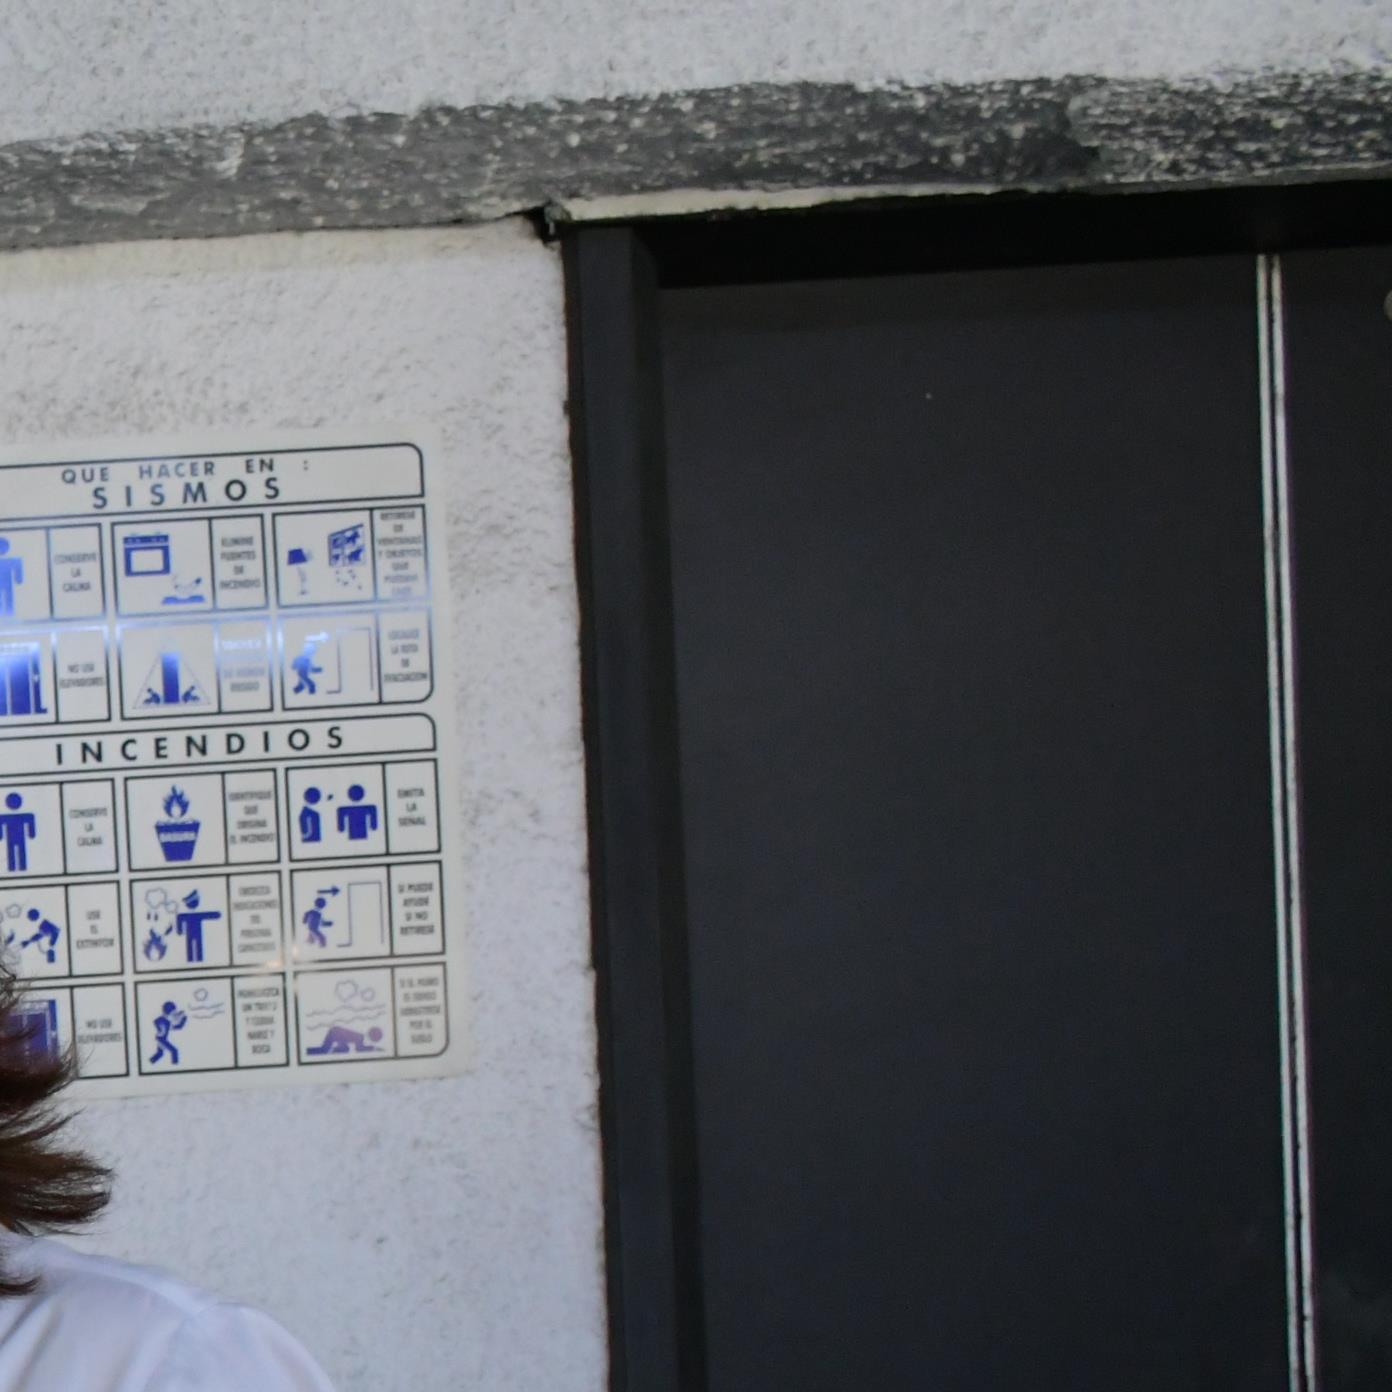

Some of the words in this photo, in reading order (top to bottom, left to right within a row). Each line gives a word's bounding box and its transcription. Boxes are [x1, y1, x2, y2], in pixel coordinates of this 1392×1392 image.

[61, 467, 110, 485] QUE
[139, 461, 216, 480] HACER
[245, 458, 274, 474] EN
[92, 477, 281, 510] SISMOS
[54, 726, 344, 766] INCENDIOS
